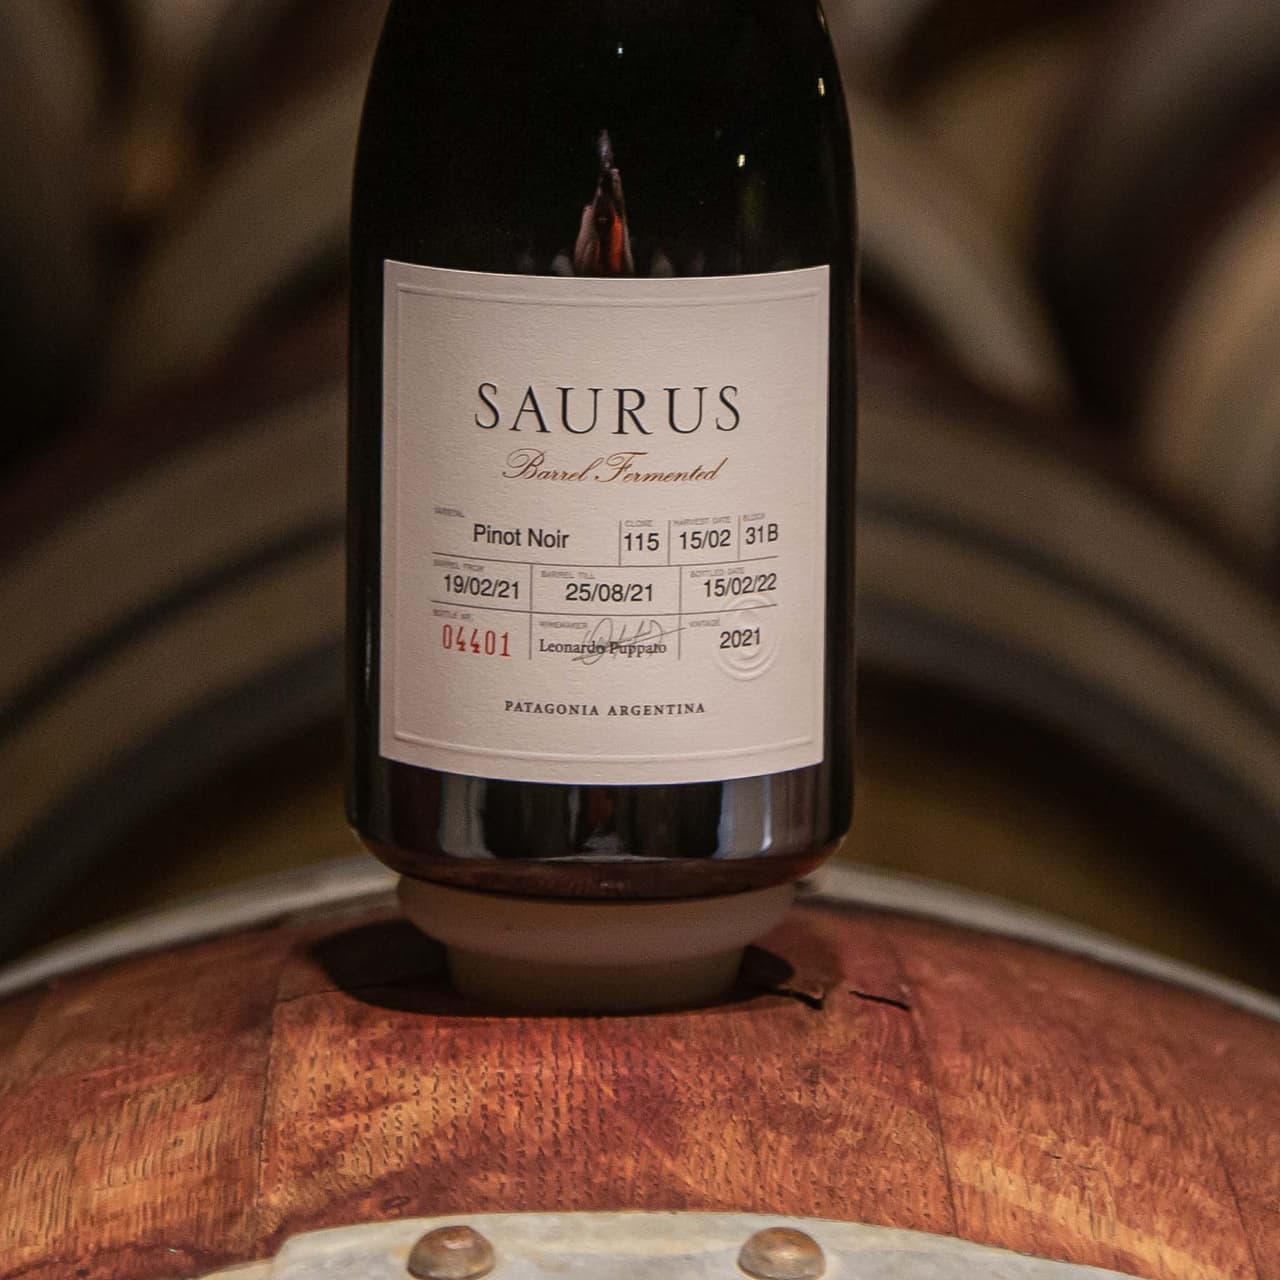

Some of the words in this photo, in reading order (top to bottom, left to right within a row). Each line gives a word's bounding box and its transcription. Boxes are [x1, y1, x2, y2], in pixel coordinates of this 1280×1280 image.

[474, 382, 741, 435] SAURUS
[501, 447, 602, 483] Barrel
[595, 450, 728, 484] Fermented
[473, 523, 523, 547] Pinot
[527, 527, 570, 549] Noir
[623, 532, 660, 552] 115
[679, 528, 732, 550] 15/02
[745, 523, 779, 545] 31B
[443, 573, 520, 600] 19/02/21
[565, 582, 654, 603] 25/08/21
[704, 572, 777, 598] 15/02/22
[441, 624, 511, 657] 04401
[539, 638, 606, 655] Leonardo
[719, 627, 761, 650] 2021
[504, 699, 600, 717] PATAGONIA
[607, 701, 706, 717] ARGENTINA
